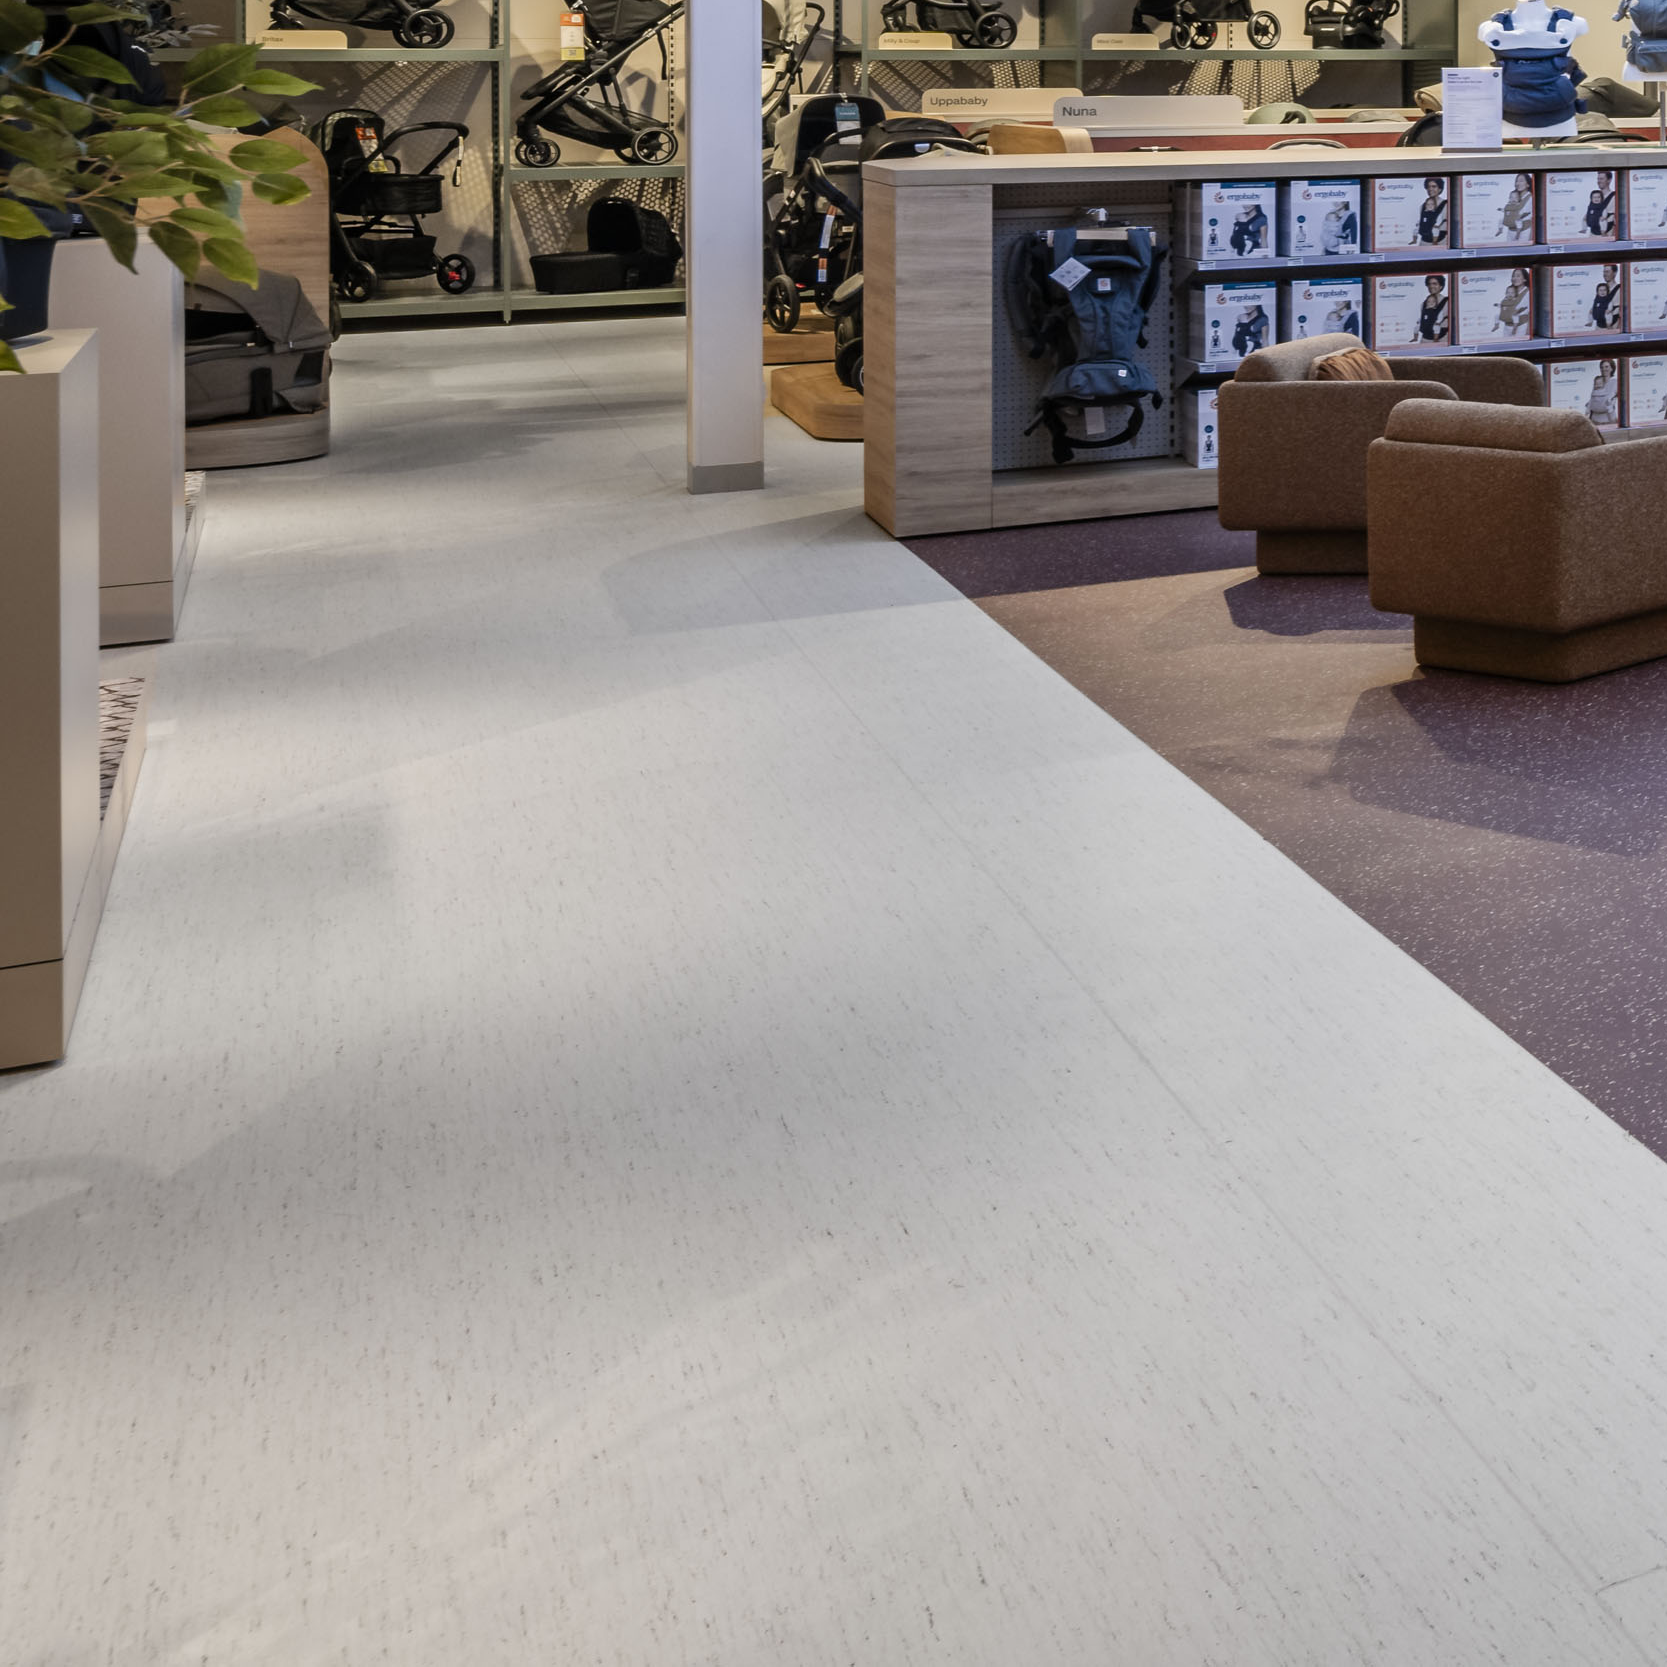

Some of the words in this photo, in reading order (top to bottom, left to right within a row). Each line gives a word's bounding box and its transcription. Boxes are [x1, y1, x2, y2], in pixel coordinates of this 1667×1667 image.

[929, 96, 988, 108] Uppababy
[1062, 106, 1097, 117] Nuna
[1226, 193, 1261, 202] ergobaby
[1314, 191, 1347, 199] ergobaby
[1229, 293, 1263, 304] ergobaby
[1315, 290, 1350, 299] ergobaby
